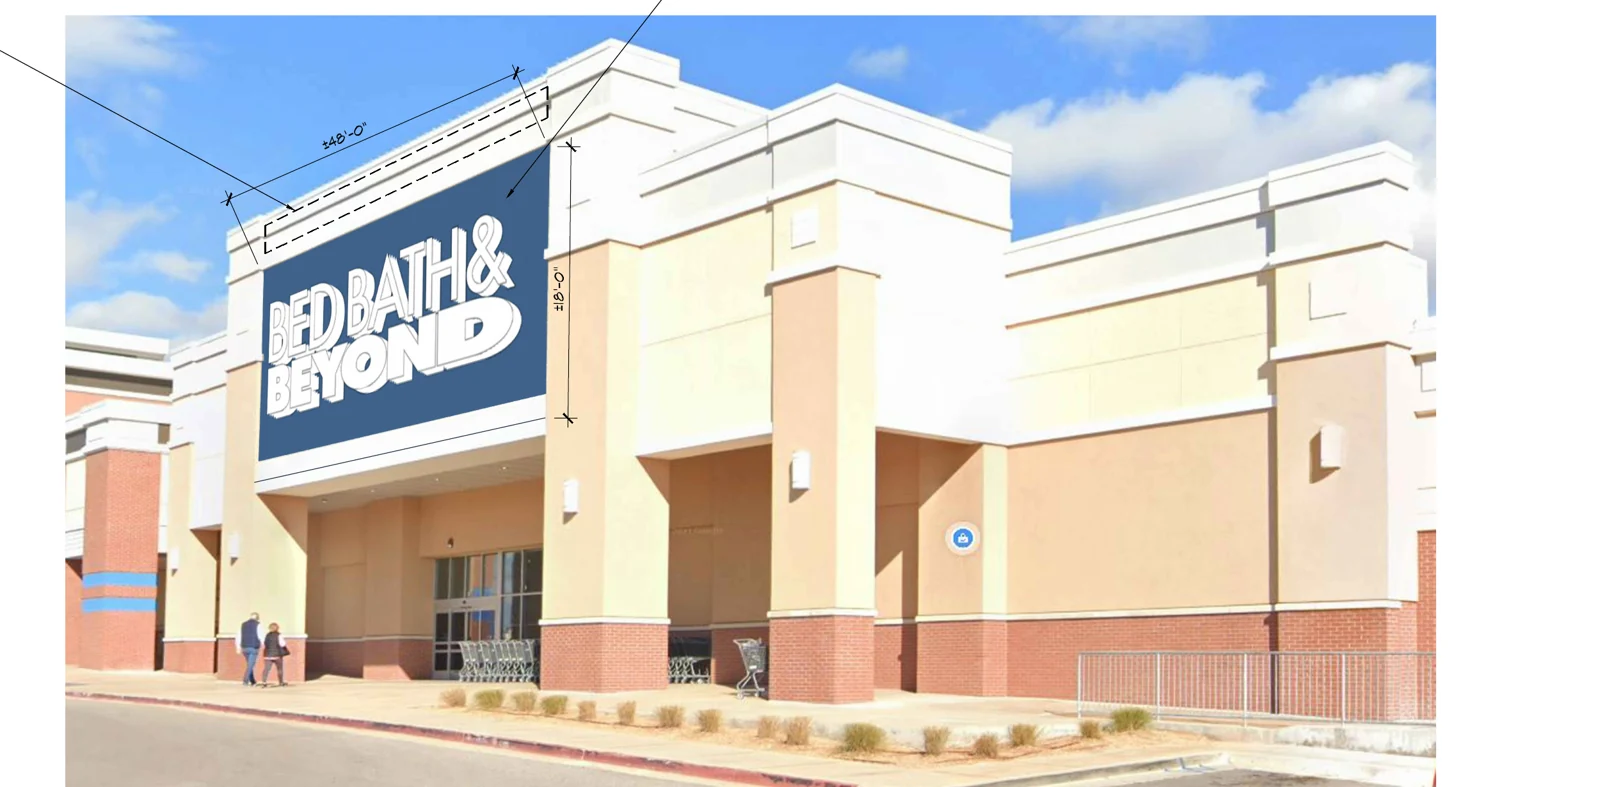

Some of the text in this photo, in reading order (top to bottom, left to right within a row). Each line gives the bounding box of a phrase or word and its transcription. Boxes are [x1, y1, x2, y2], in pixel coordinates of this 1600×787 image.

[266, 296, 522, 419] BEYOND
[269, 214, 515, 366] BED BATH &
